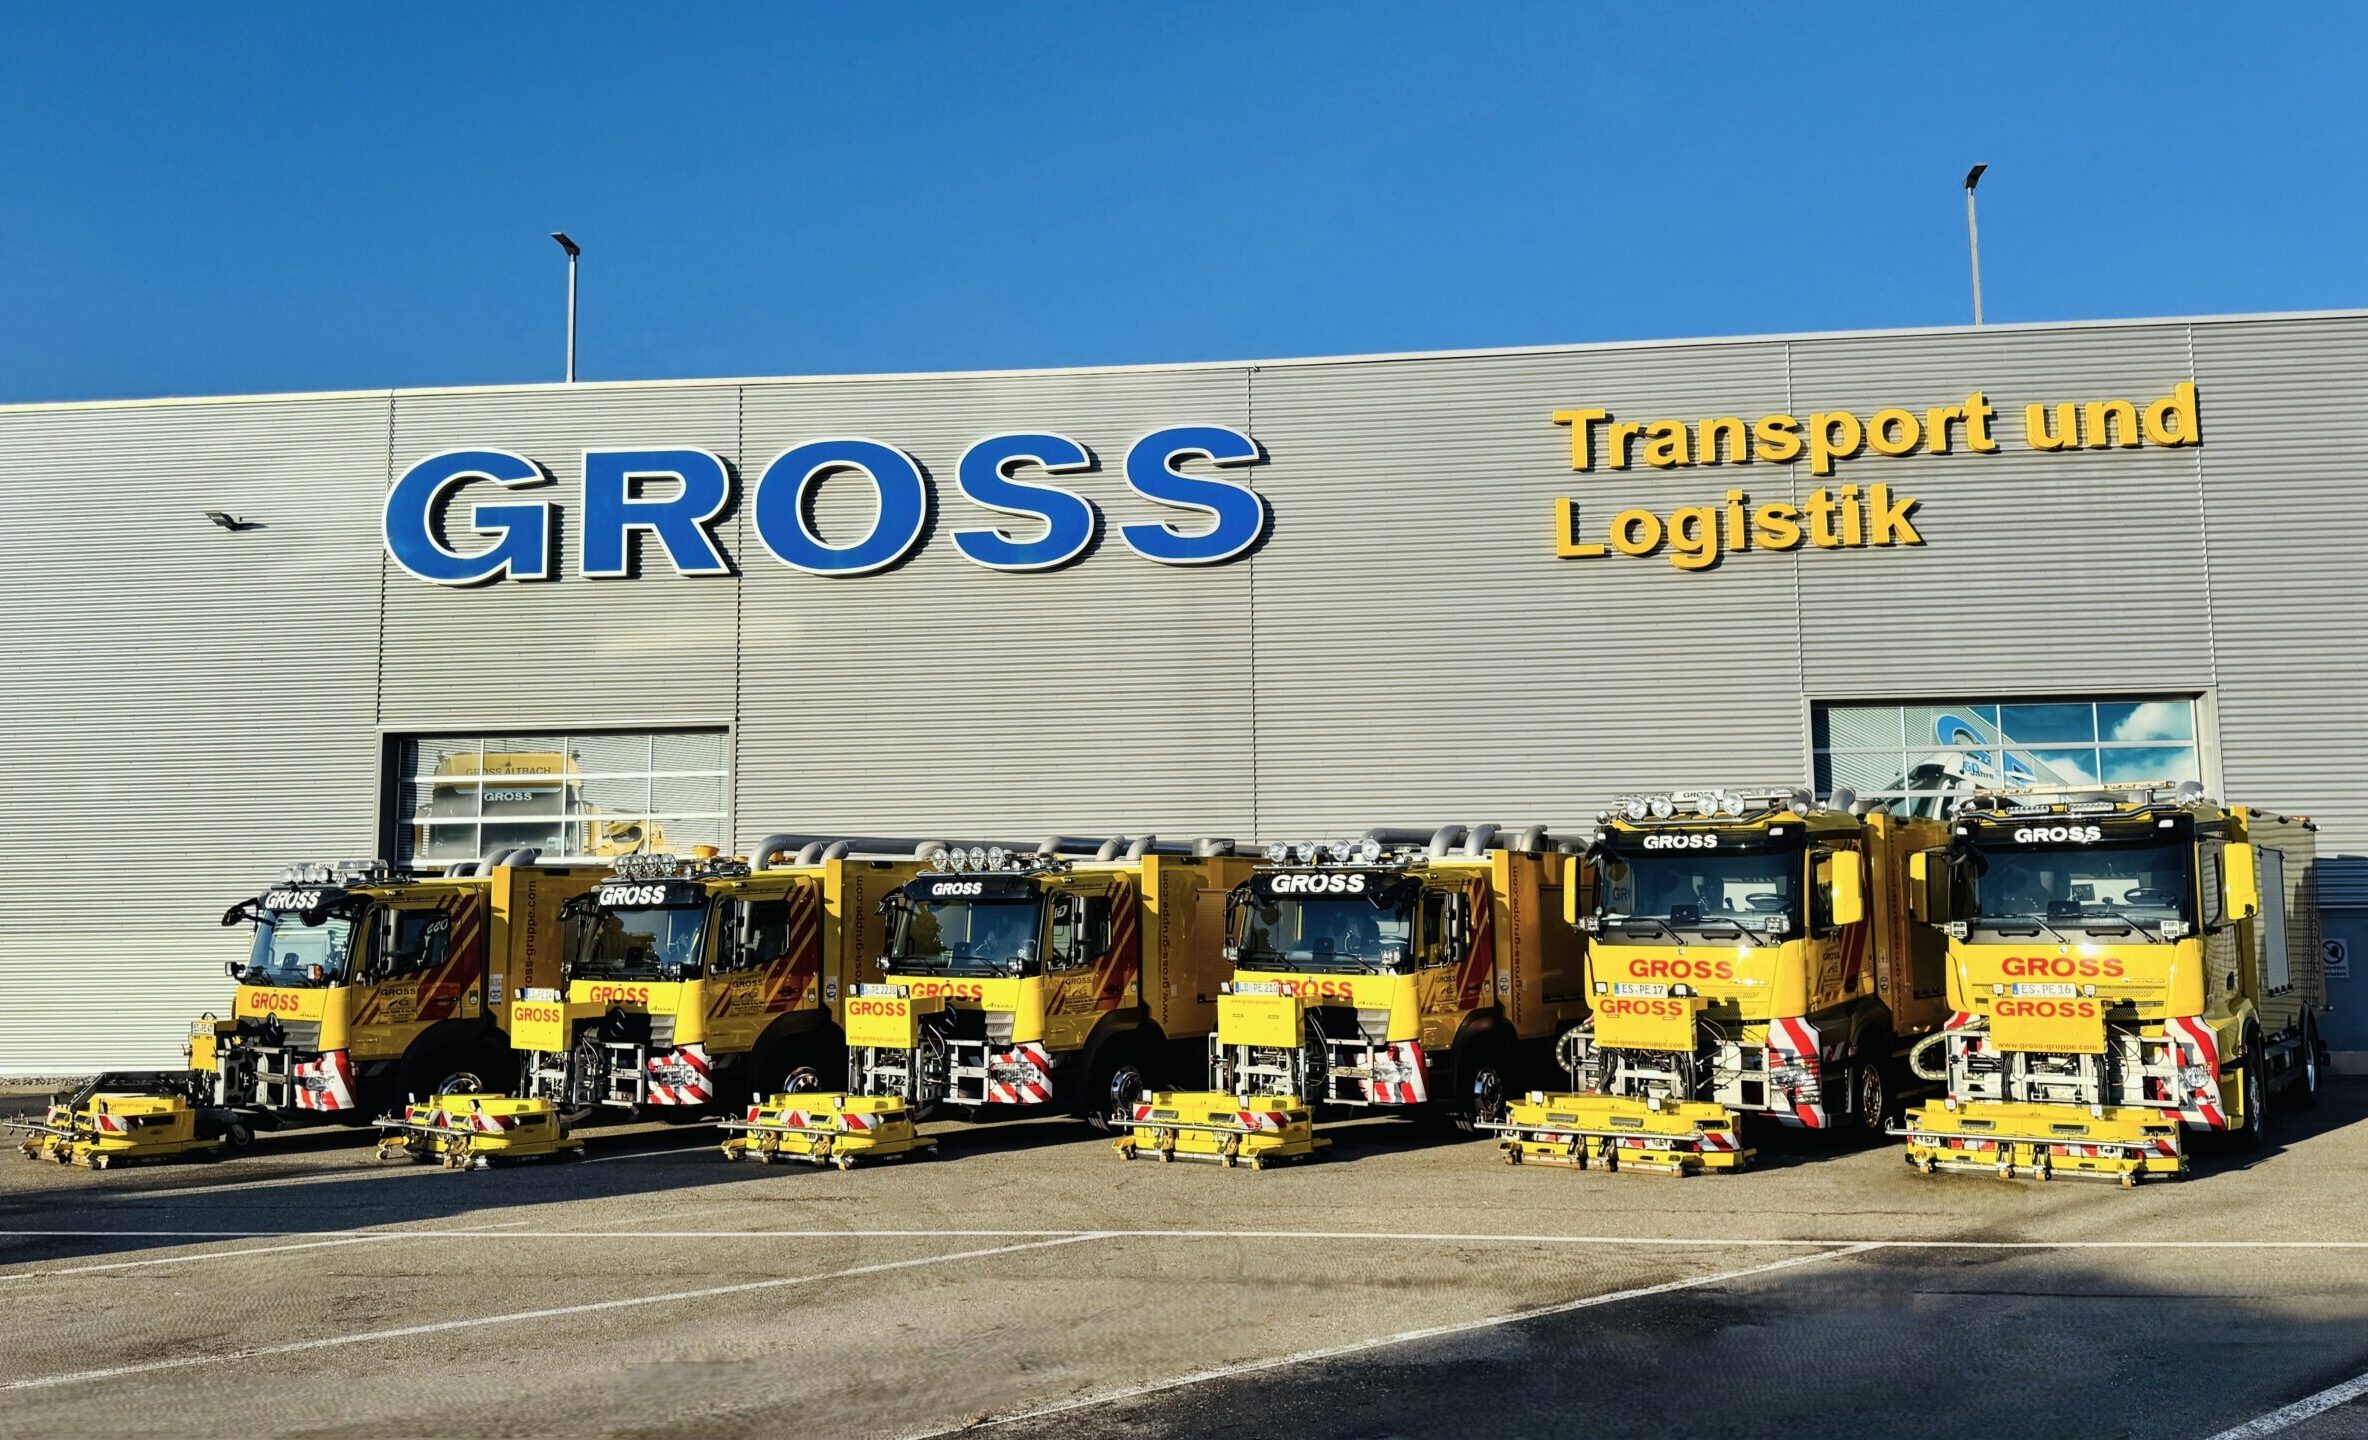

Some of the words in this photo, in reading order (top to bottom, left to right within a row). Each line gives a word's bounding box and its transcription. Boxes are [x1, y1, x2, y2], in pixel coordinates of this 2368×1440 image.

[1552, 390, 1997, 477] Transport
[2025, 381, 2200, 452] und
[381, 423, 1266, 587] GROSS
[1555, 481, 1924, 571] Logistik
[484, 792, 533, 802] GROSS
[1643, 834, 1718, 850] GROSS
[2013, 825, 2102, 844] GROSS
[932, 881, 983, 896] GROSS
[1271, 873, 1366, 893] GROSS
[264, 890, 321, 910] GROSS
[600, 884, 667, 906] GROSS
[525, 880, 538, 989] ross-gruppe.com
[854, 874, 865, 984] ross-gruppe.com
[1160, 870, 1170, 1025] www.gross-gruppe.com
[1511, 865, 1523, 1025] www.gross-gruppe.com
[1629, 958, 1734, 980] GROSS
[2001, 957, 2125, 977] GROSS
[732, 979, 764, 989] GROSS
[1065, 976, 1092, 986] GROSS
[251, 991, 300, 1012] GROSS
[381, 987, 417, 996] GROSS
[590, 985, 649, 1005] GROSS
[912, 982, 983, 1003] GROSS
[514, 1006, 561, 1024] GROSS
[849, 1001, 907, 1017] GROSS
[1599, 999, 1683, 1016] GROSS
[1995, 1000, 2096, 1018] GROSS
[1601, 1038, 1686, 1049] www.gross-gruppe.com
[1997, 1041, 2098, 1052] www.gross-gruppe.com
